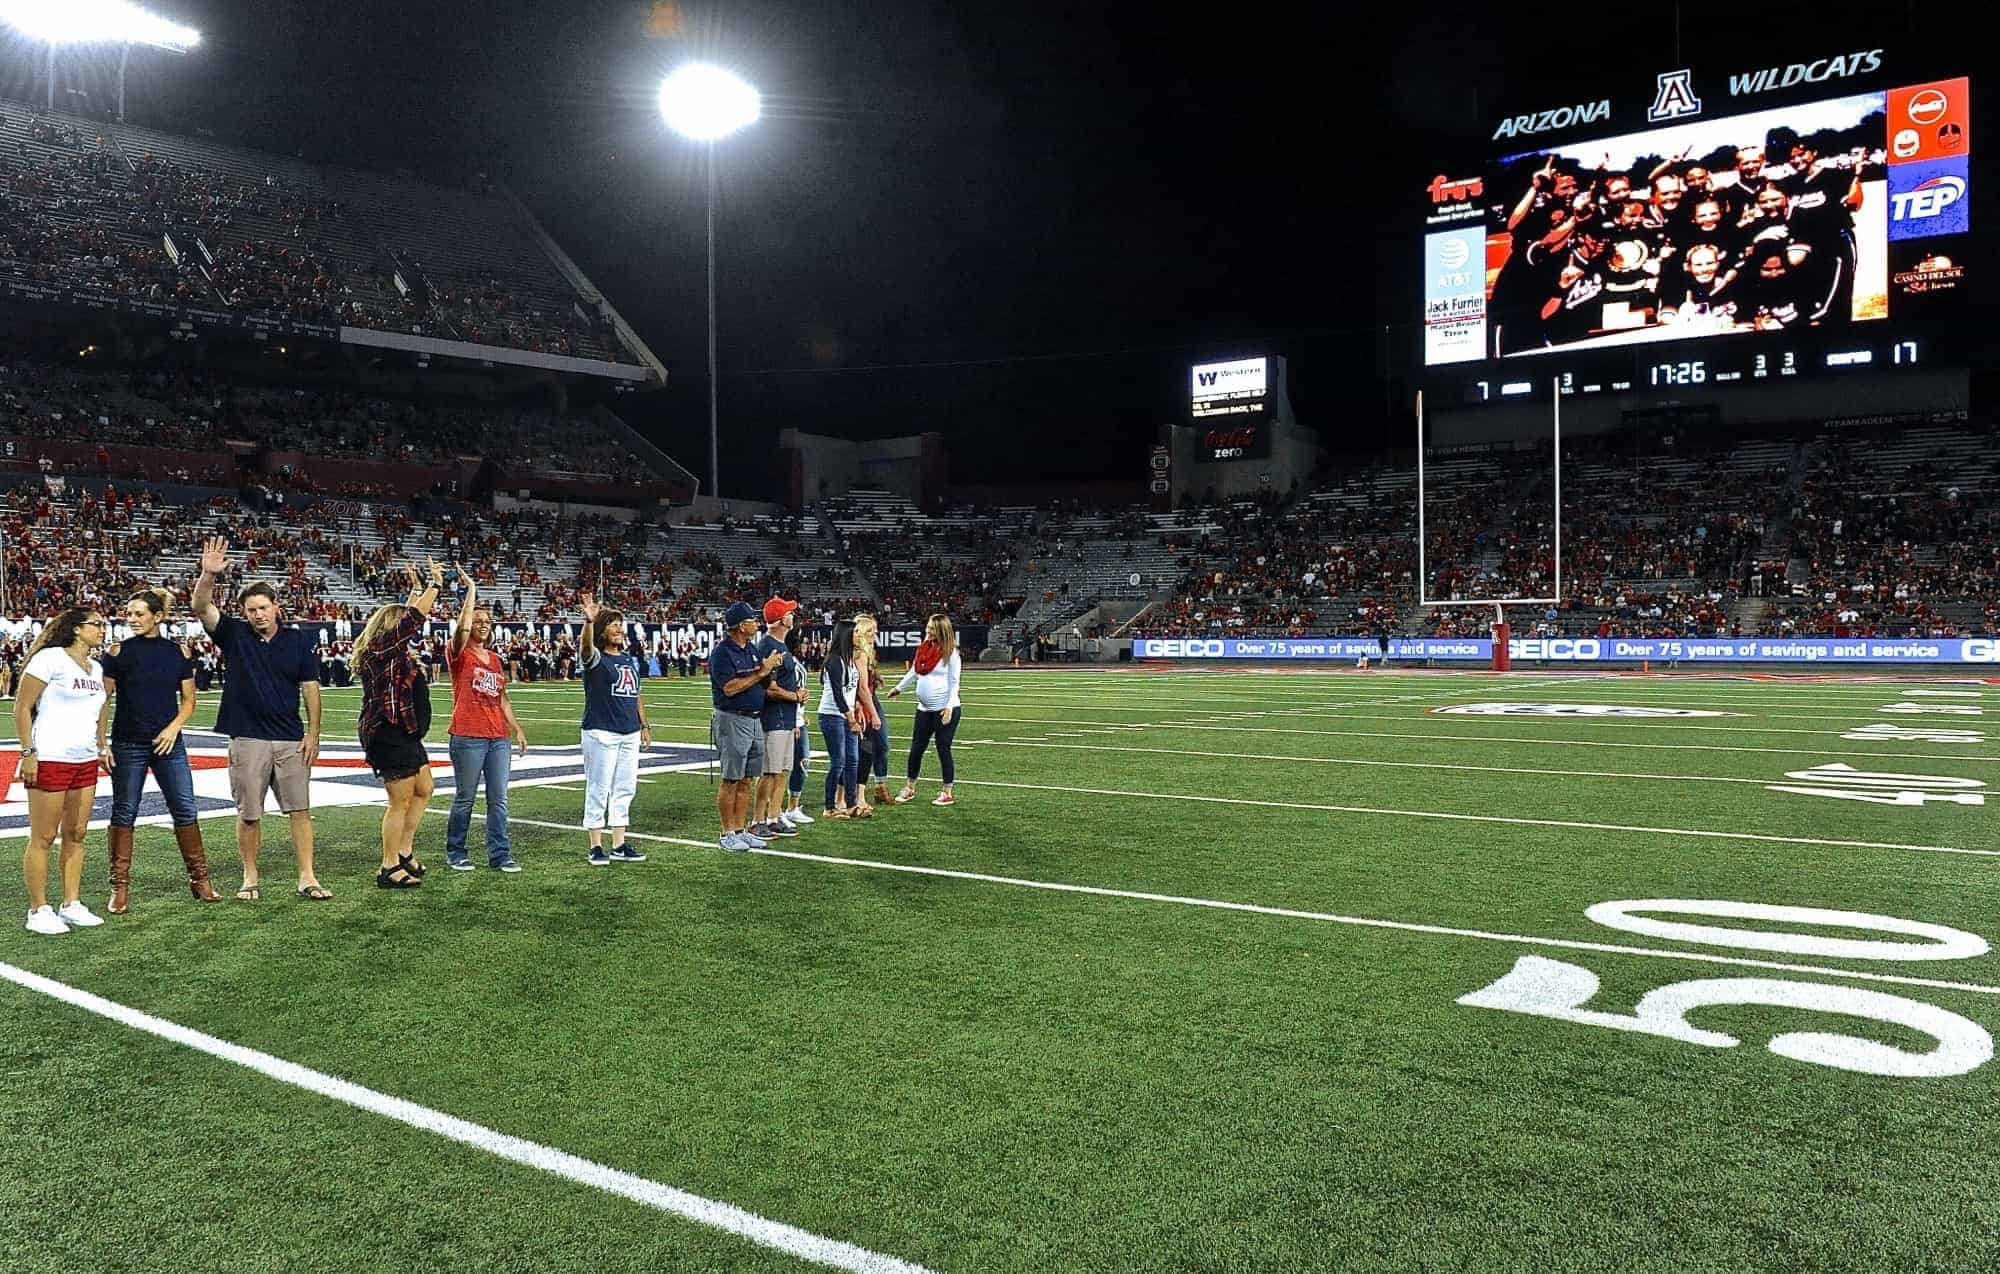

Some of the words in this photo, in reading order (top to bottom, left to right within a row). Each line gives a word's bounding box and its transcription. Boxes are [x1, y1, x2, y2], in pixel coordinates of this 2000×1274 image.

[1729, 49, 1883, 96] WILDCATS
[1648, 68, 1701, 122] A
[1492, 100, 1610, 141] ARIZONA
[1891, 186, 1960, 221] TEP
[1428, 299, 1448, 313] Jack
[1452, 296, 1483, 311] Furrier
[1756, 354, 1766, 369] 3
[1784, 352, 1795, 367] 3
[1894, 342, 1917, 364] 17
[1198, 371, 1218, 386] W
[1563, 372, 1573, 387] 3
[1651, 362, 1706, 386] 17:26
[1477, 381, 1489, 400] 7
[1214, 447, 1243, 459] zero
[1145, 639, 1225, 657] GEICO
[1236, 642, 1265, 654] Over
[1269, 642, 1286, 654] 75
[1291, 644, 1324, 657] years
[1329, 642, 1342, 655] of
[1399, 642, 1425, 655] and
[1429, 642, 1479, 655] service
[1616, 642, 1654, 656] Over
[1660, 642, 1681, 656] 75
[1687, 644, 1734, 660] years
[1739, 643, 1756, 656] of
[1761, 643, 1827, 660] savings
[1833, 643, 1867, 657] and
[1872, 643, 1939, 657] service
[72, 678, 103, 691] ARIZO
[611, 664, 640, 697] A
[1456, 898, 1993, 1077] 50
